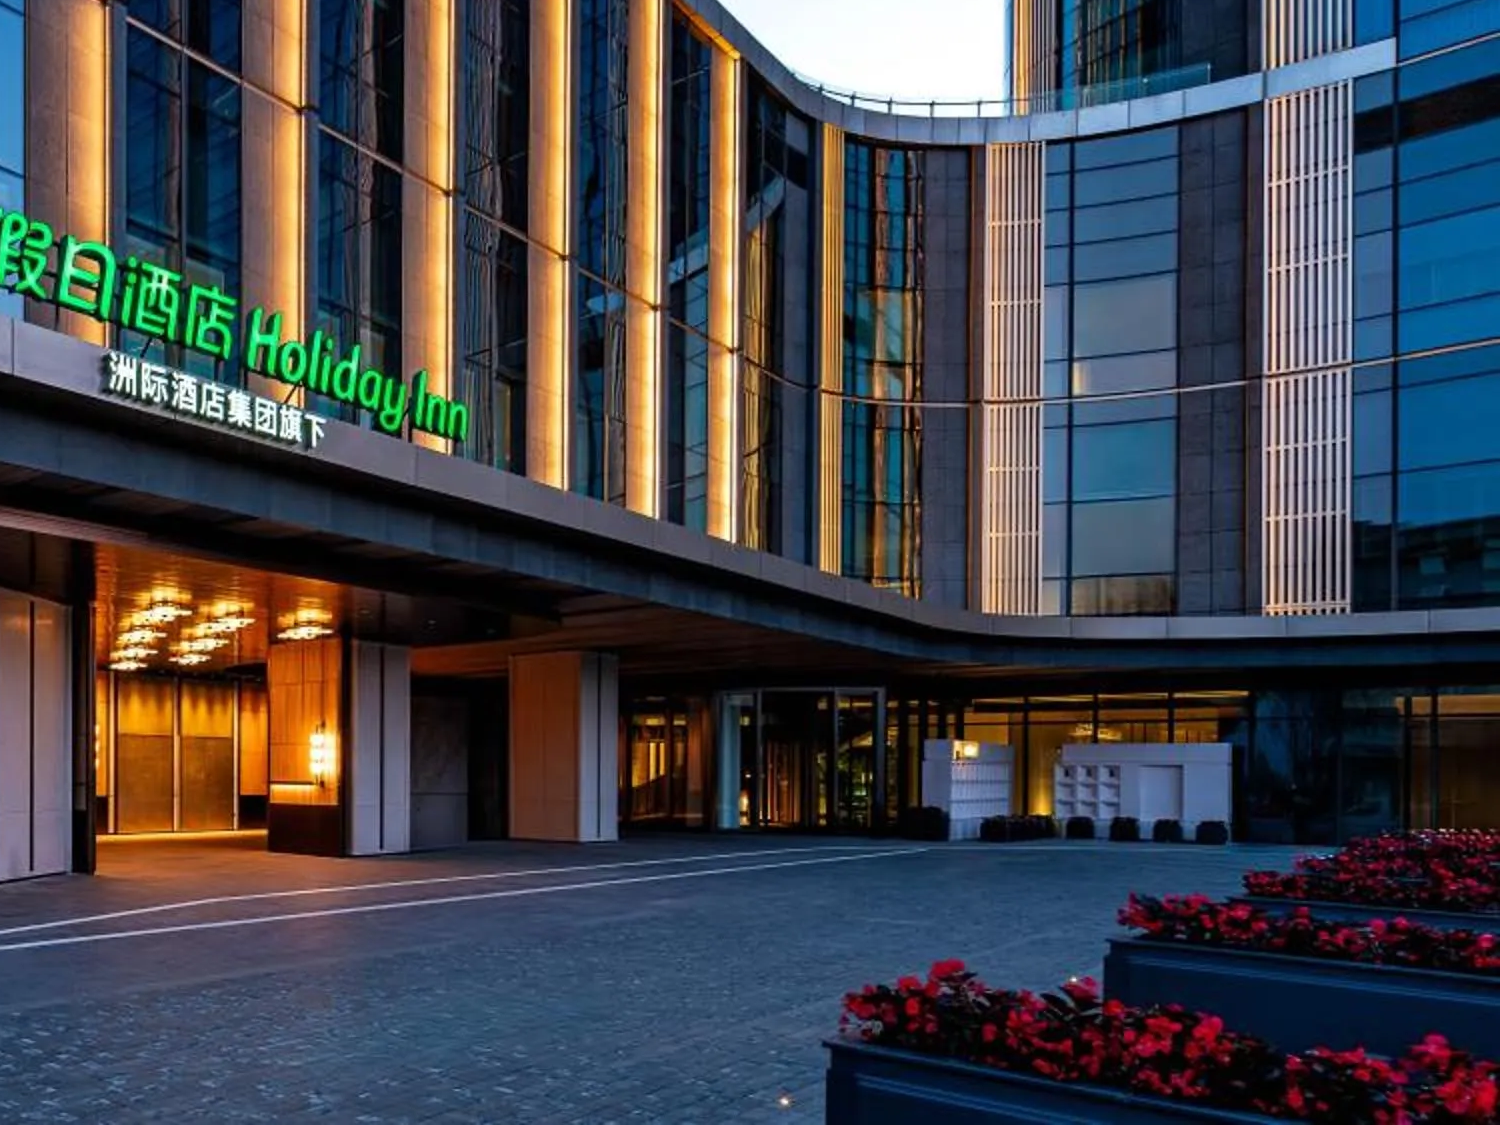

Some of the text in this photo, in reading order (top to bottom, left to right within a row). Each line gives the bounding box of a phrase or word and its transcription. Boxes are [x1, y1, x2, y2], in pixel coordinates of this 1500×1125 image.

[109, 351, 327, 448] 洲际酒店集团旗下
[246, 307, 408, 432] Holiday
[414, 370, 469, 442] Inn
